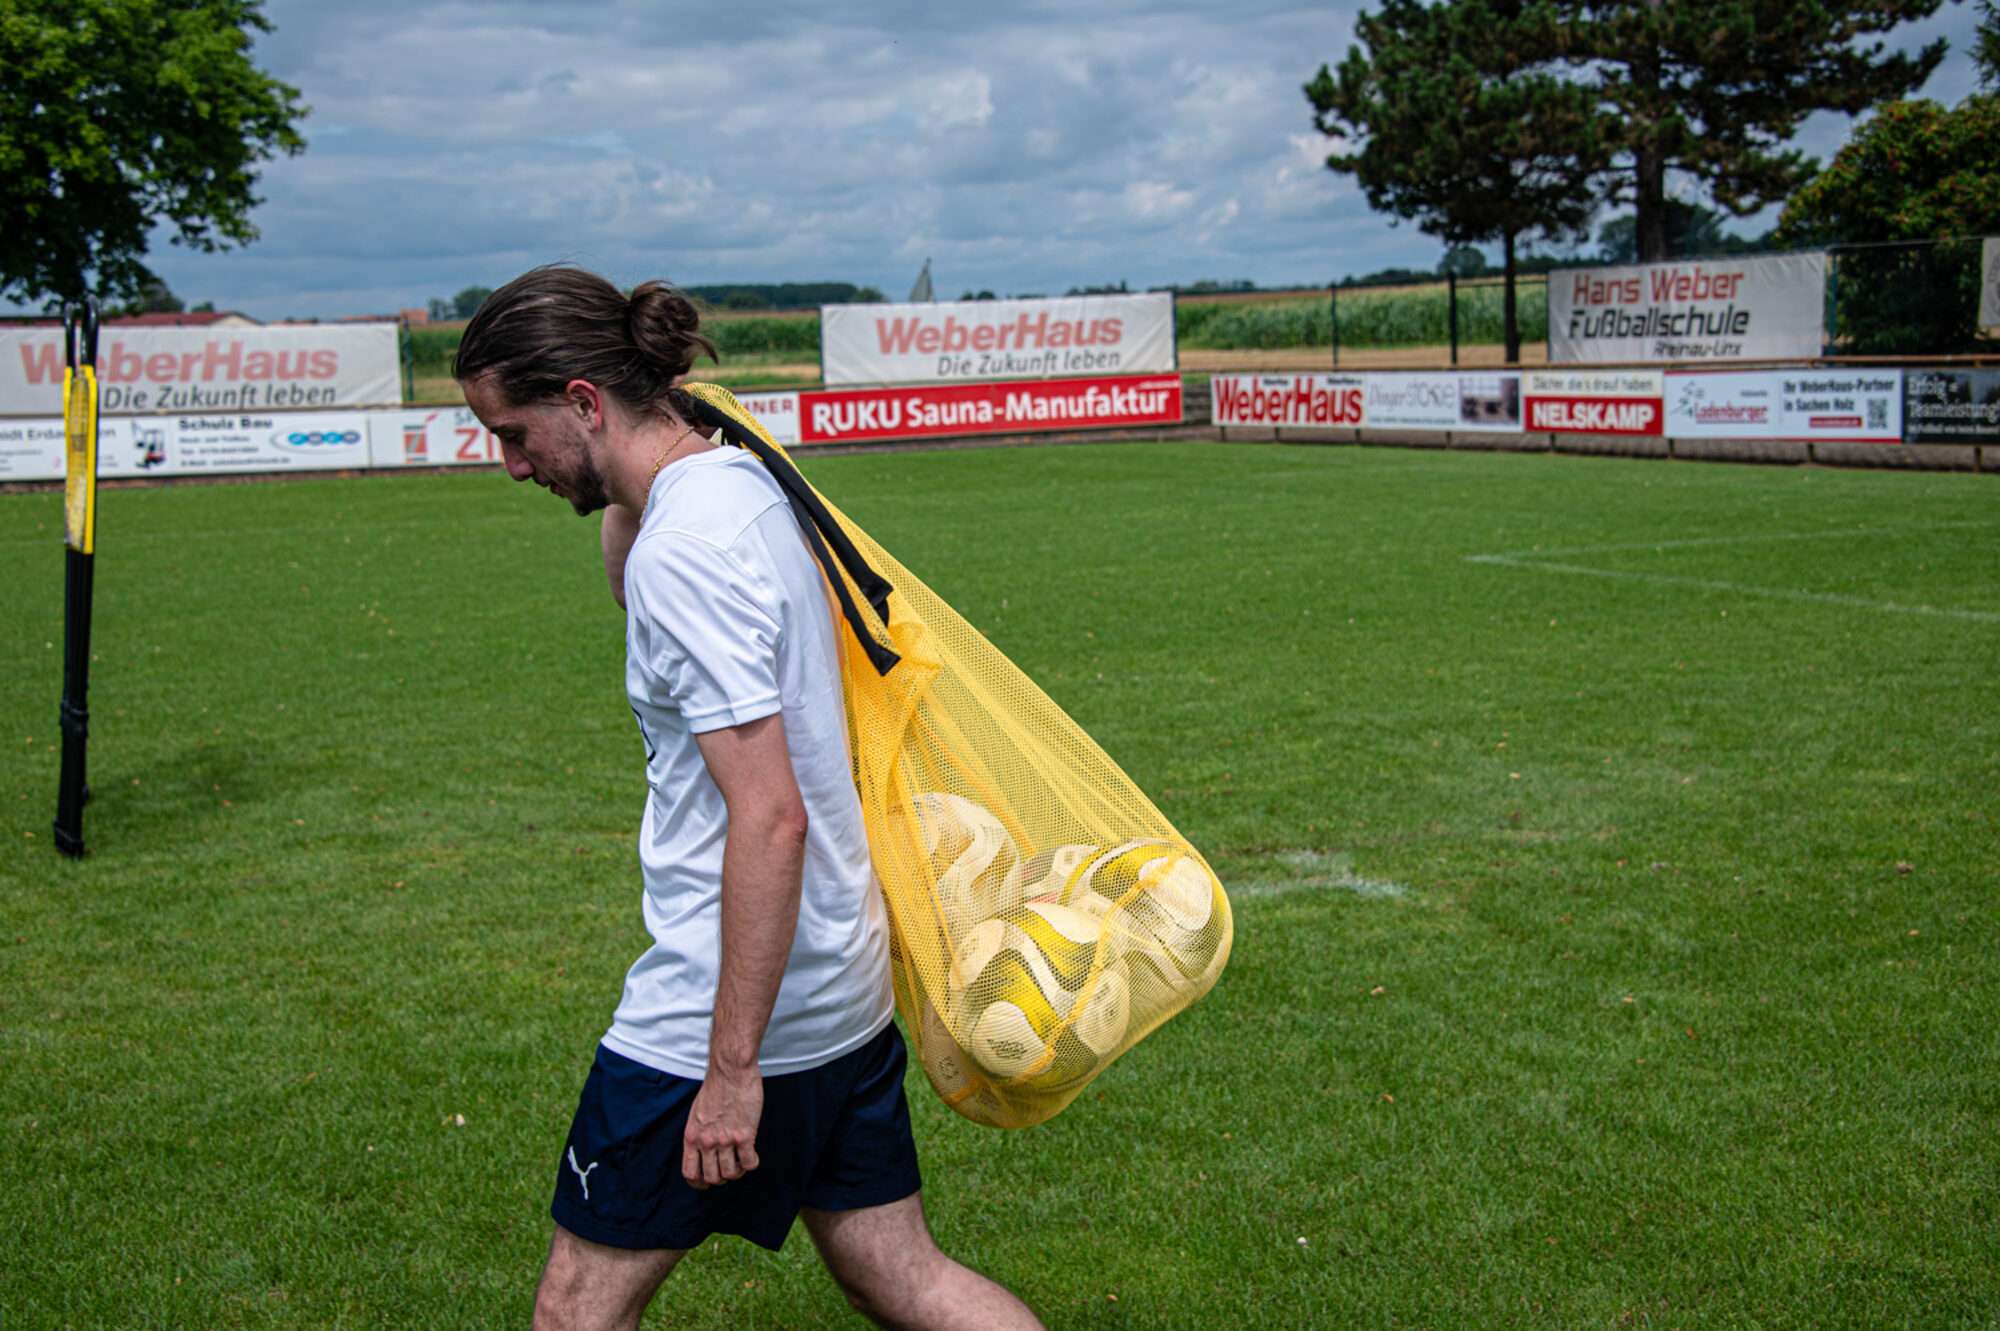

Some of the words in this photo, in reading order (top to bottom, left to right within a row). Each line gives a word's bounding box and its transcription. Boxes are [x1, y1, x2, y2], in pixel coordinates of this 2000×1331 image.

[1573, 274, 1641, 305] Hans
[1650, 267, 1744, 302] Weber
[876, 312, 1123, 354] WeberHaus
[1568, 305, 1749, 339] Fußballschule
[937, 356, 970, 377] Die
[979, 351, 1058, 377] Zukunft
[1064, 349, 1120, 370] leben
[104, 387, 147, 410] Die
[157, 384, 256, 411] Zukunft
[266, 383, 335, 405] leben
[812, 398, 901, 436] RUKU
[905, 386, 1170, 429] Sauna-Manufaktur
[1215, 376, 1363, 424] WeberHaus
[1532, 402, 1654, 430] NELSKAMP
